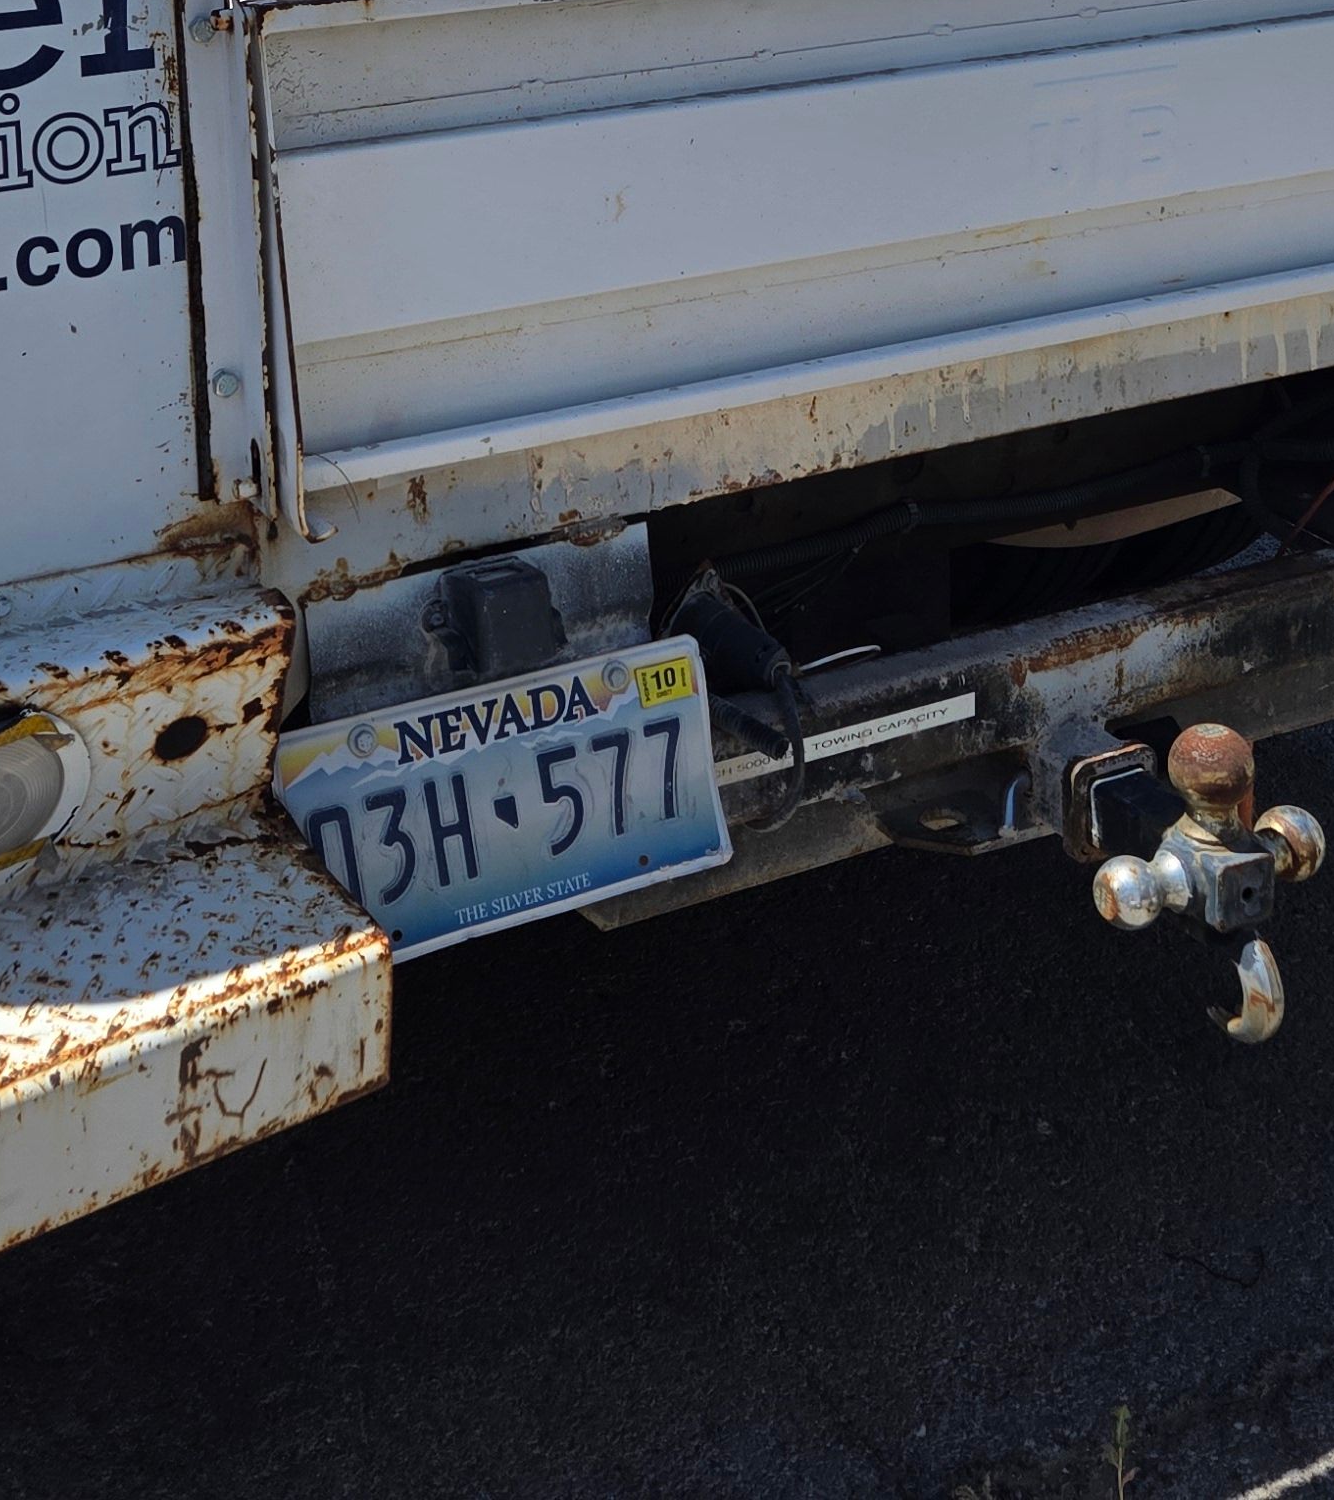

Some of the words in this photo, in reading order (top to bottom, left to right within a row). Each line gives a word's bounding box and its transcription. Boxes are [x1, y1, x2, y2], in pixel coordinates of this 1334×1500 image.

[650, 667, 676, 690] 10
[394, 676, 598, 765] NEVADA
[812, 729, 873, 750] TOWING
[877, 707, 949, 734] CAPACITY
[455, 905, 489, 925] THE
[491, 887, 543, 915] SILVER
[546, 872, 591, 899] STATE
